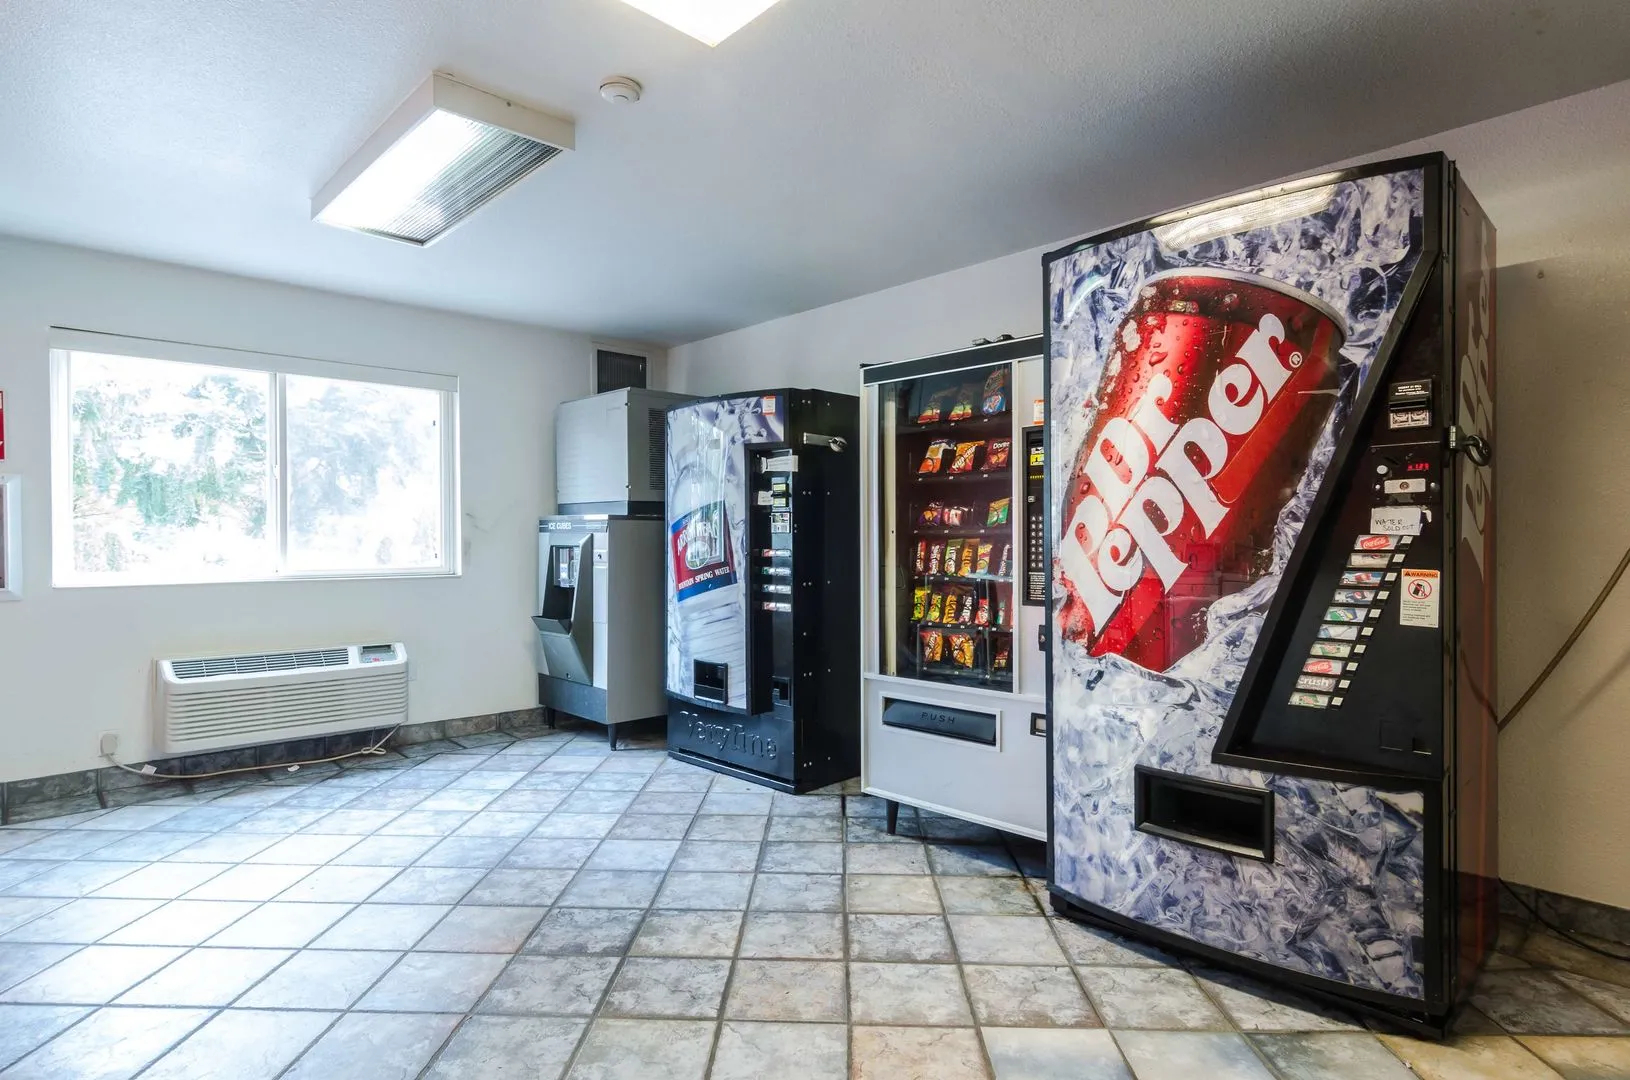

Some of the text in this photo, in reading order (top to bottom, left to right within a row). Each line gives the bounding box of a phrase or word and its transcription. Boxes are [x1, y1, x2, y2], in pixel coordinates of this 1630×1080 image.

[1062, 313, 1293, 634] Dr Pepper
[548, 522, 572, 530] ICE CUBES
[1382, 524, 1401, 532] SOLD
[694, 570, 713, 583] SPRING
[714, 566, 730, 576] WATER
[920, 711, 957, 724] PUSH
[680, 711, 777, 760] Veryfine
